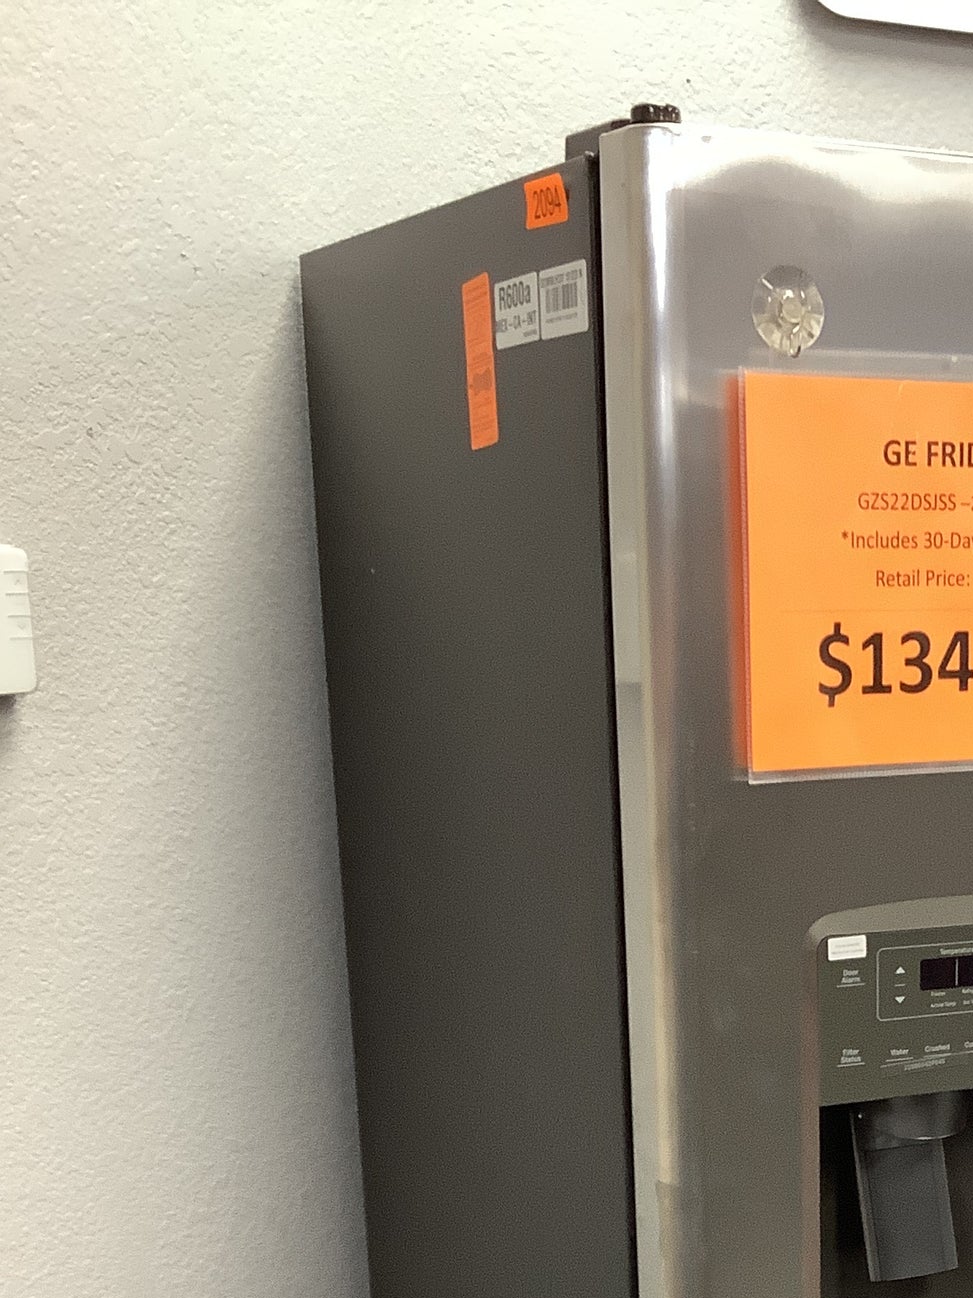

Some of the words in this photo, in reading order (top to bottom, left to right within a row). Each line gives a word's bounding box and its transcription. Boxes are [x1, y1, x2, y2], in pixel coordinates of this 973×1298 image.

[532, 185, 562, 220] 2094
[498, 280, 531, 311] R600a
[883, 439, 918, 468] GE
[857, 492, 957, 512] GZS22DSJSS
[875, 569, 920, 587] Retail
[926, 569, 970, 587] Price:
